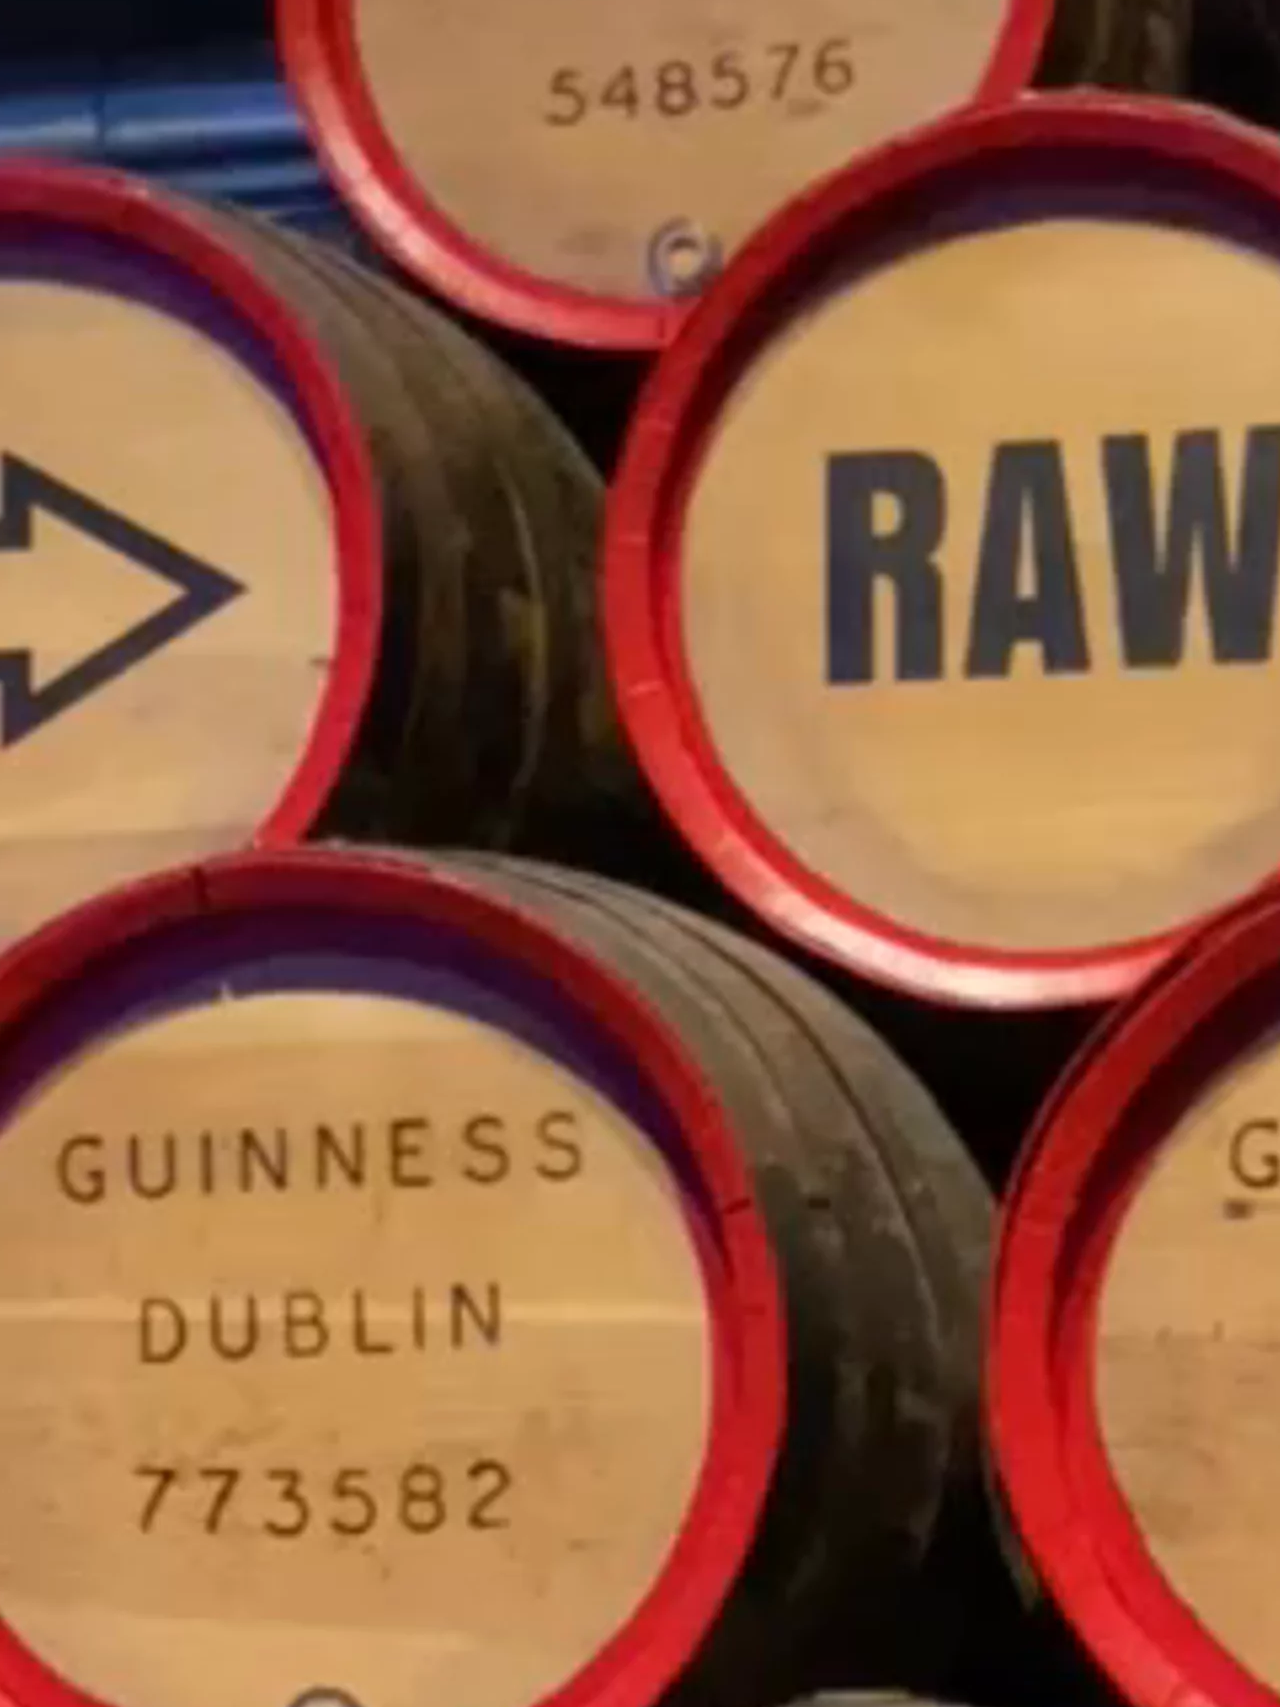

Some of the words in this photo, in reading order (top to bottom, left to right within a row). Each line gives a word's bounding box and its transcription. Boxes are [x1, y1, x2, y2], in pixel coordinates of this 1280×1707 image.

[542, 37, 856, 128] 548576
[55, 1111, 584, 1205] GUINNESS
[137, 1281, 505, 1365] DUBLIN
[131, 1459, 515, 1538] 773582
